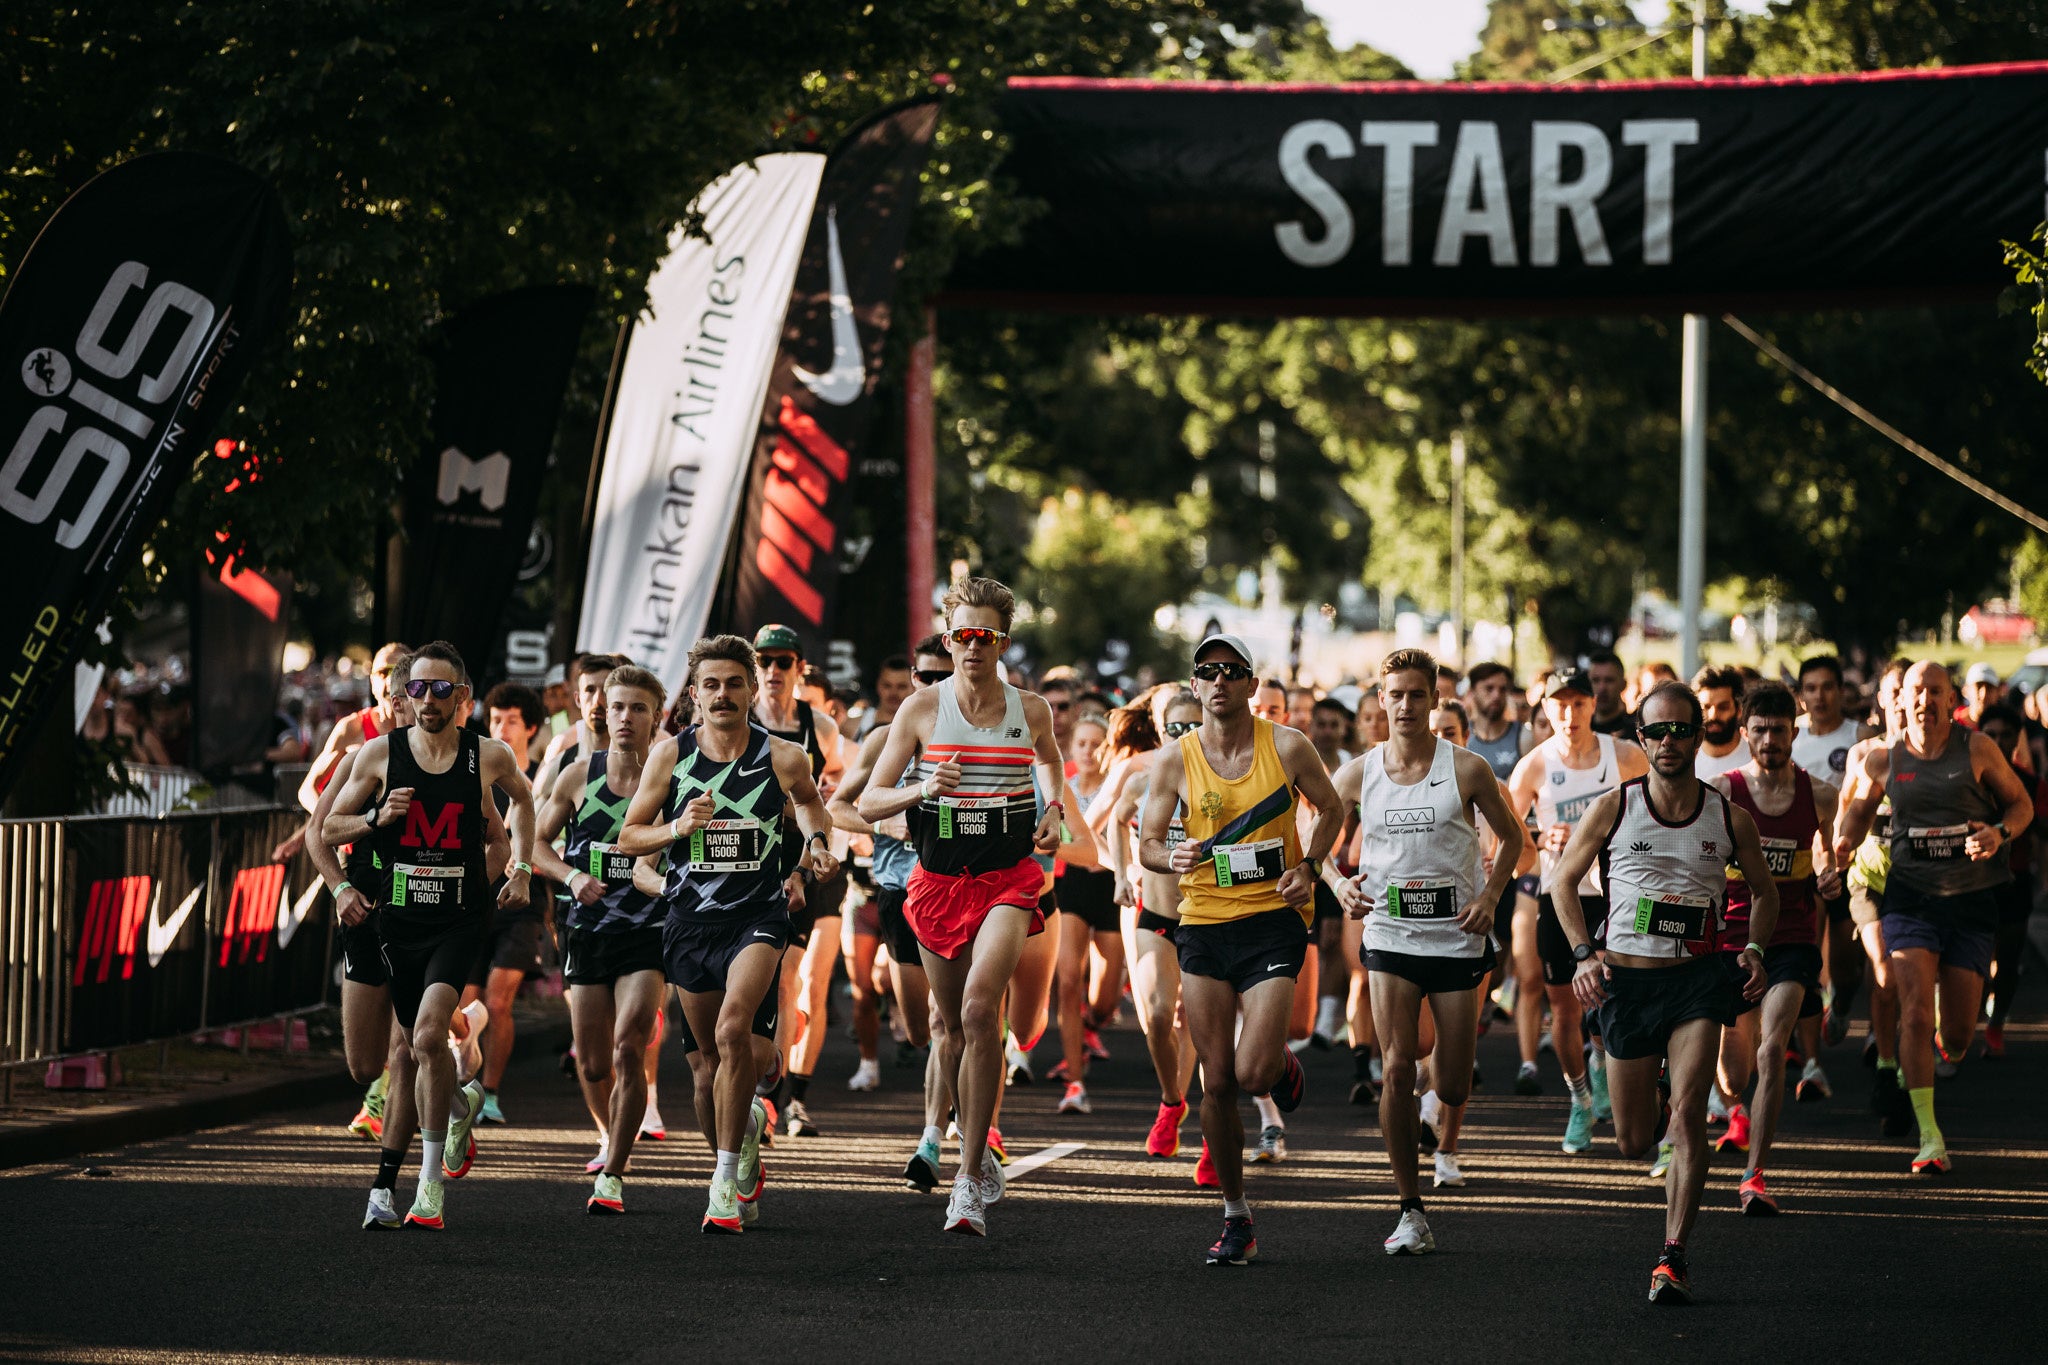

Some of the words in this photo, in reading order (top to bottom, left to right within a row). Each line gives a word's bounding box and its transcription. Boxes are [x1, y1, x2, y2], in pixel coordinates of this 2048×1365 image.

[1274, 118, 1700, 268] START
[671, 249, 745, 442] Airlines
[186, 321, 240, 411] SPORT
[1564, 796, 1593, 820] HN
[400, 800, 464, 849] M
[956, 811, 988, 823] JBRUCE
[941, 818, 949, 837] ELITE
[959, 823, 987, 835] 15008
[706, 833, 740, 846] RAYNER
[692, 841, 701, 862] ELITE
[710, 846, 738, 858] 15009
[610, 856, 630, 868] REID
[607, 867, 632, 879] 15000
[1219, 866, 1229, 885] ELITE
[1238, 866, 1265, 880] 15028
[408, 878, 446, 893] MCNEILL
[394, 884, 403, 904] ELITE
[412, 891, 441, 904] 15003
[1402, 892, 1438, 903] VINCENT
[1389, 897, 1397, 916] ELITE
[1407, 903, 1435, 915] 15023
[1636, 910, 1648, 932] ELITE
[1658, 919, 1686, 935] 15030
